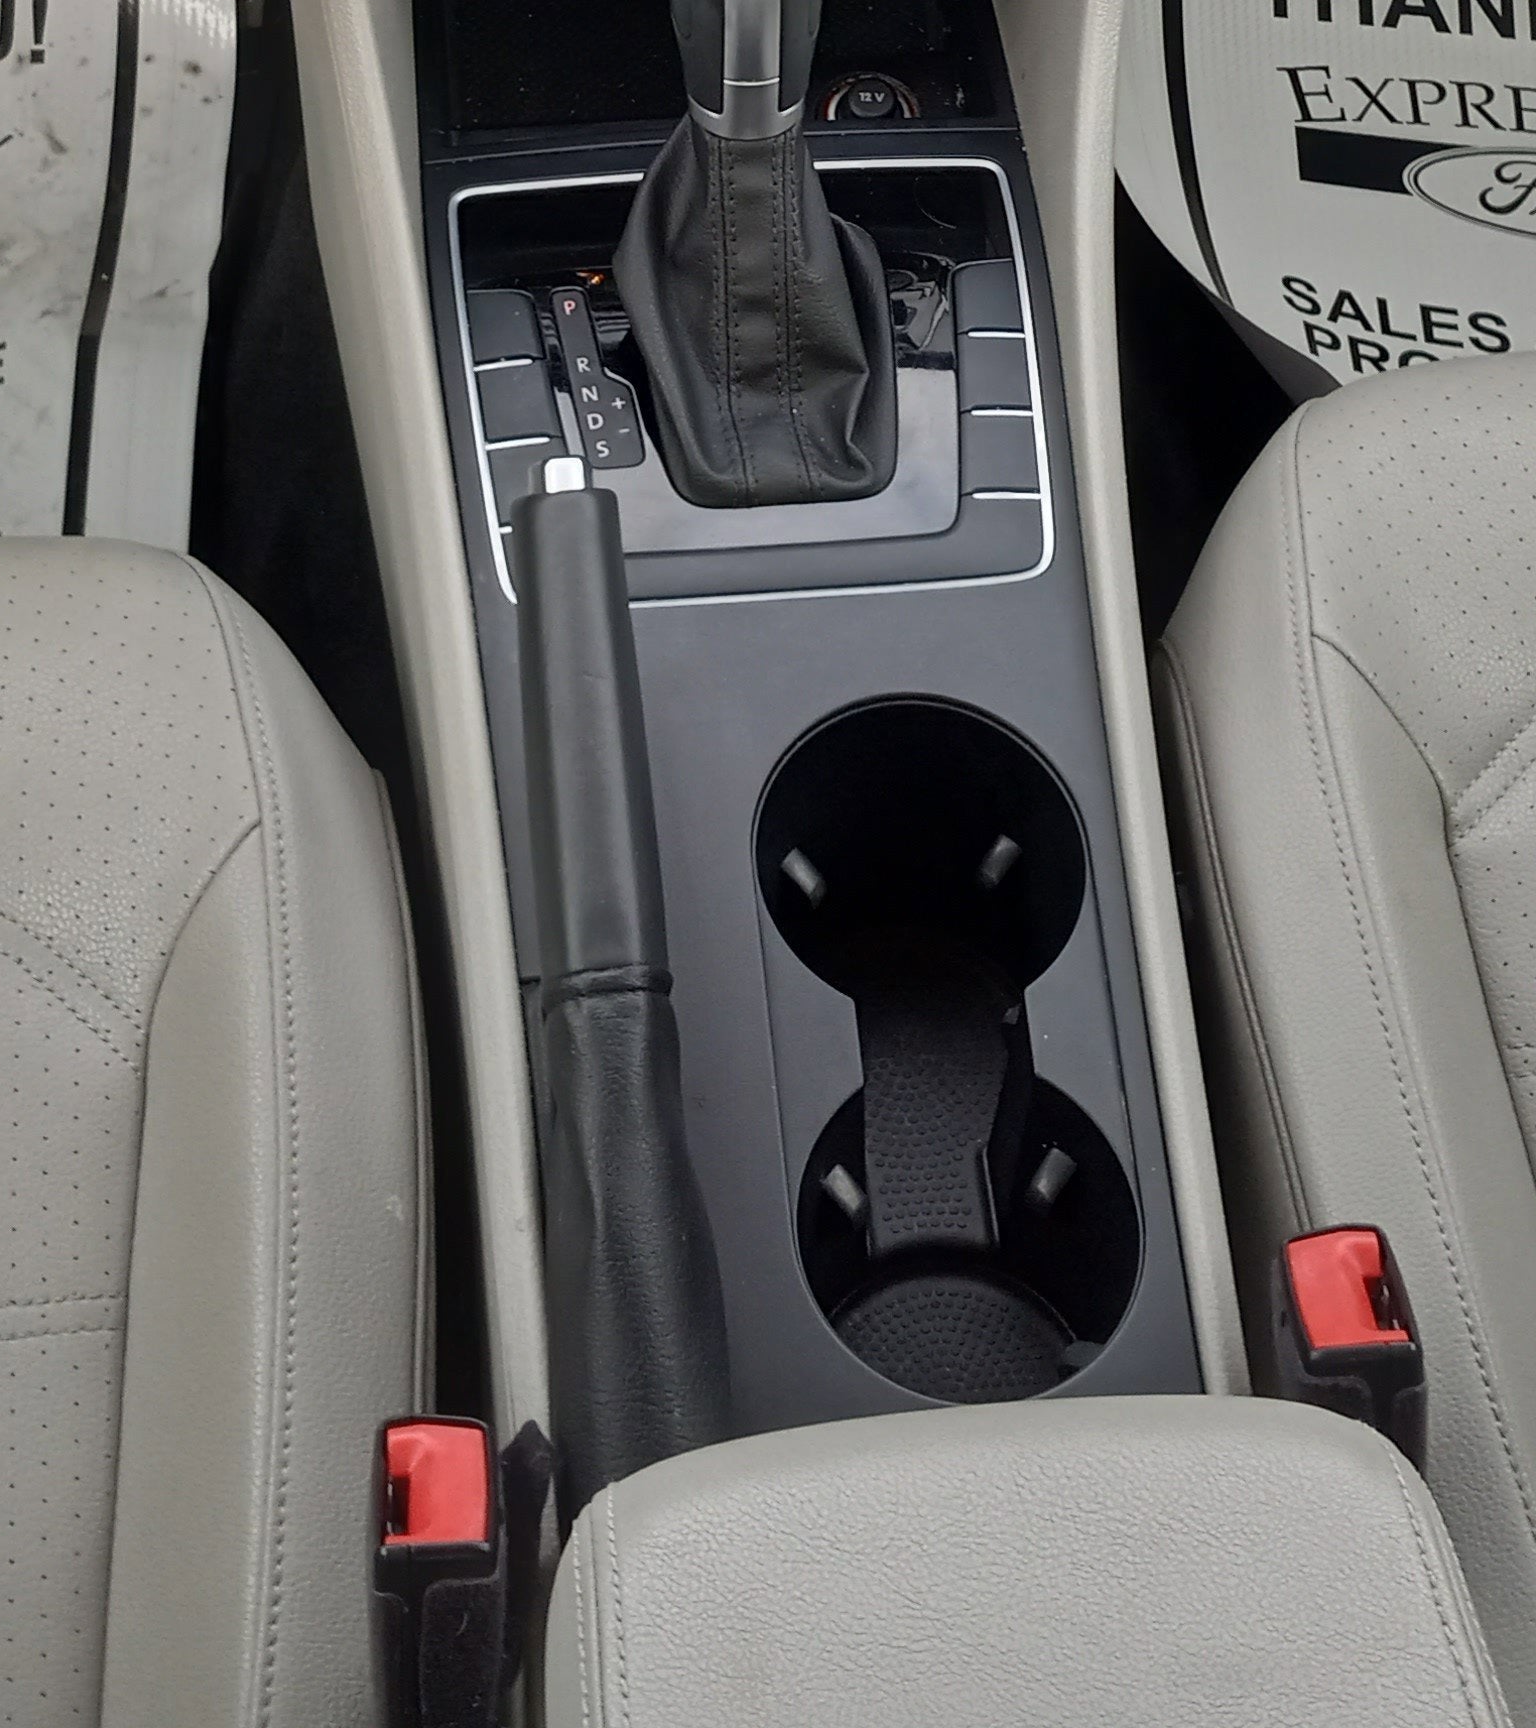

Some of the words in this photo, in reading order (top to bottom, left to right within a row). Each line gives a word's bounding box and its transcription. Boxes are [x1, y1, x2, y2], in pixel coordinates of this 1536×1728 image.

[859, 92, 872, 102] 12
[874, 92, 885, 103] V
[563, 300, 576, 315] P
[1281, 275, 1511, 355] SALES
[576, 357, 591, 373] R
[581, 385, 599, 402] N
[587, 413, 604, 430] D
[596, 440, 610, 458] S
